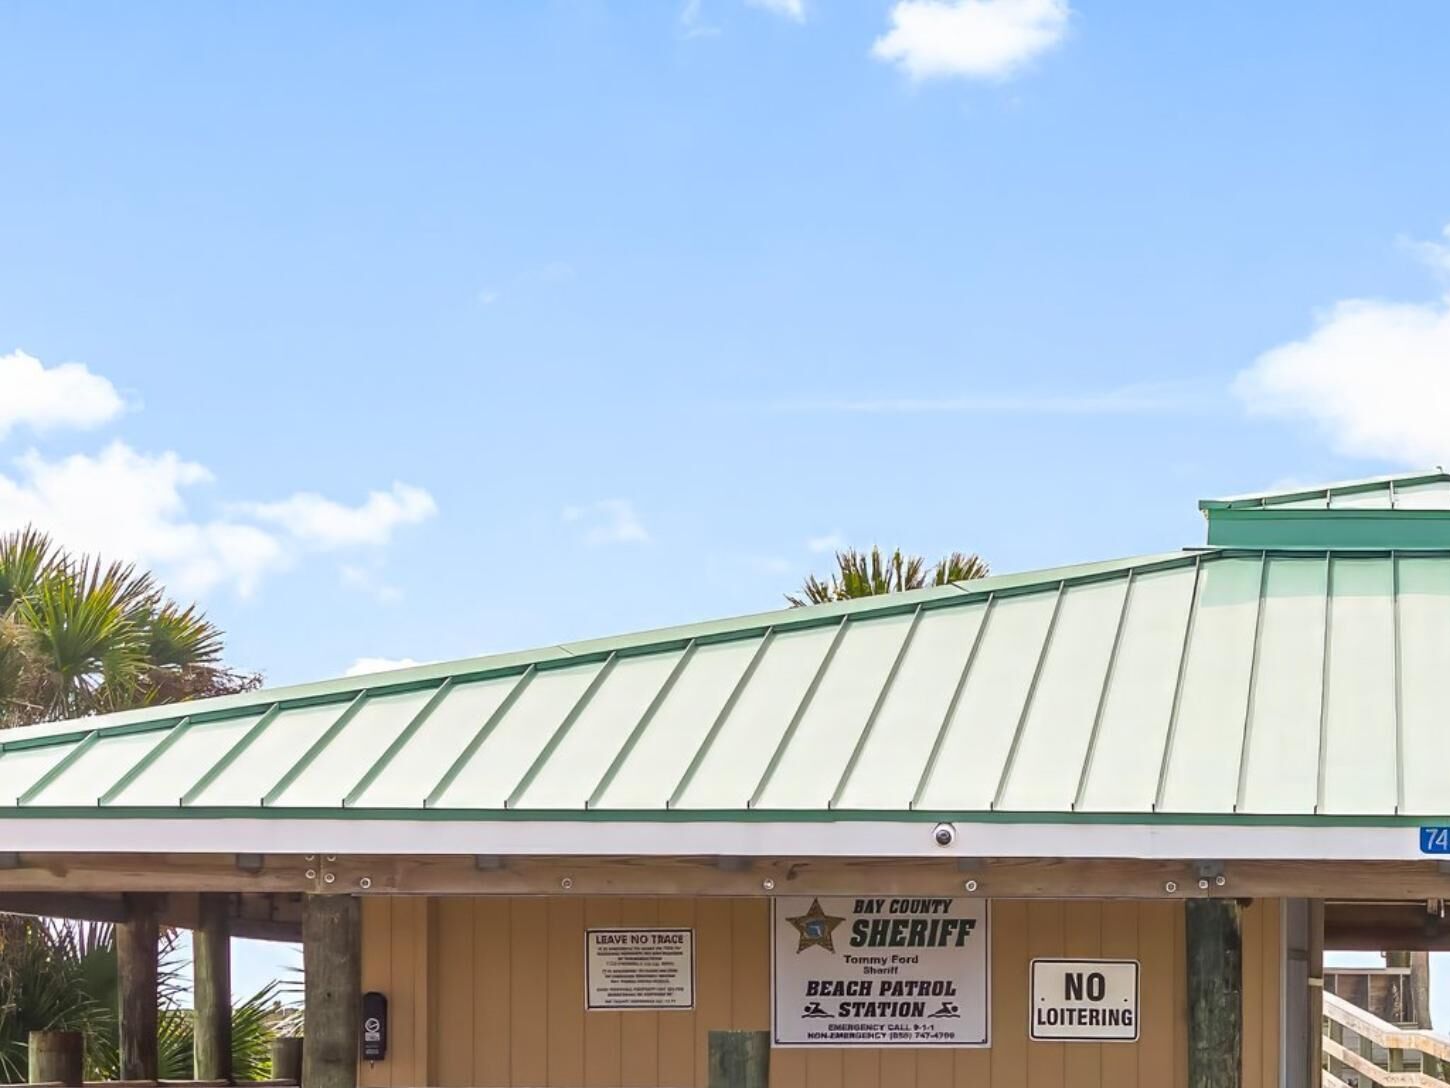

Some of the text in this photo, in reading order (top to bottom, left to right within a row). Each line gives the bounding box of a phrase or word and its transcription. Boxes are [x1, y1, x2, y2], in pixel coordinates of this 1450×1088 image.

[853, 899, 953, 914] BAY COUNTY
[595, 934, 684, 944] LEAVE NO TRACE
[849, 918, 976, 947] SHERIFF
[843, 954, 919, 965] Tommy Ford
[863, 966, 898, 975] Sheriff
[805, 980, 956, 997] BEACH PATROL
[1064, 972, 1106, 1002] NO
[838, 1001, 925, 1018] STATION
[1037, 1007, 1133, 1026] LOITERING
